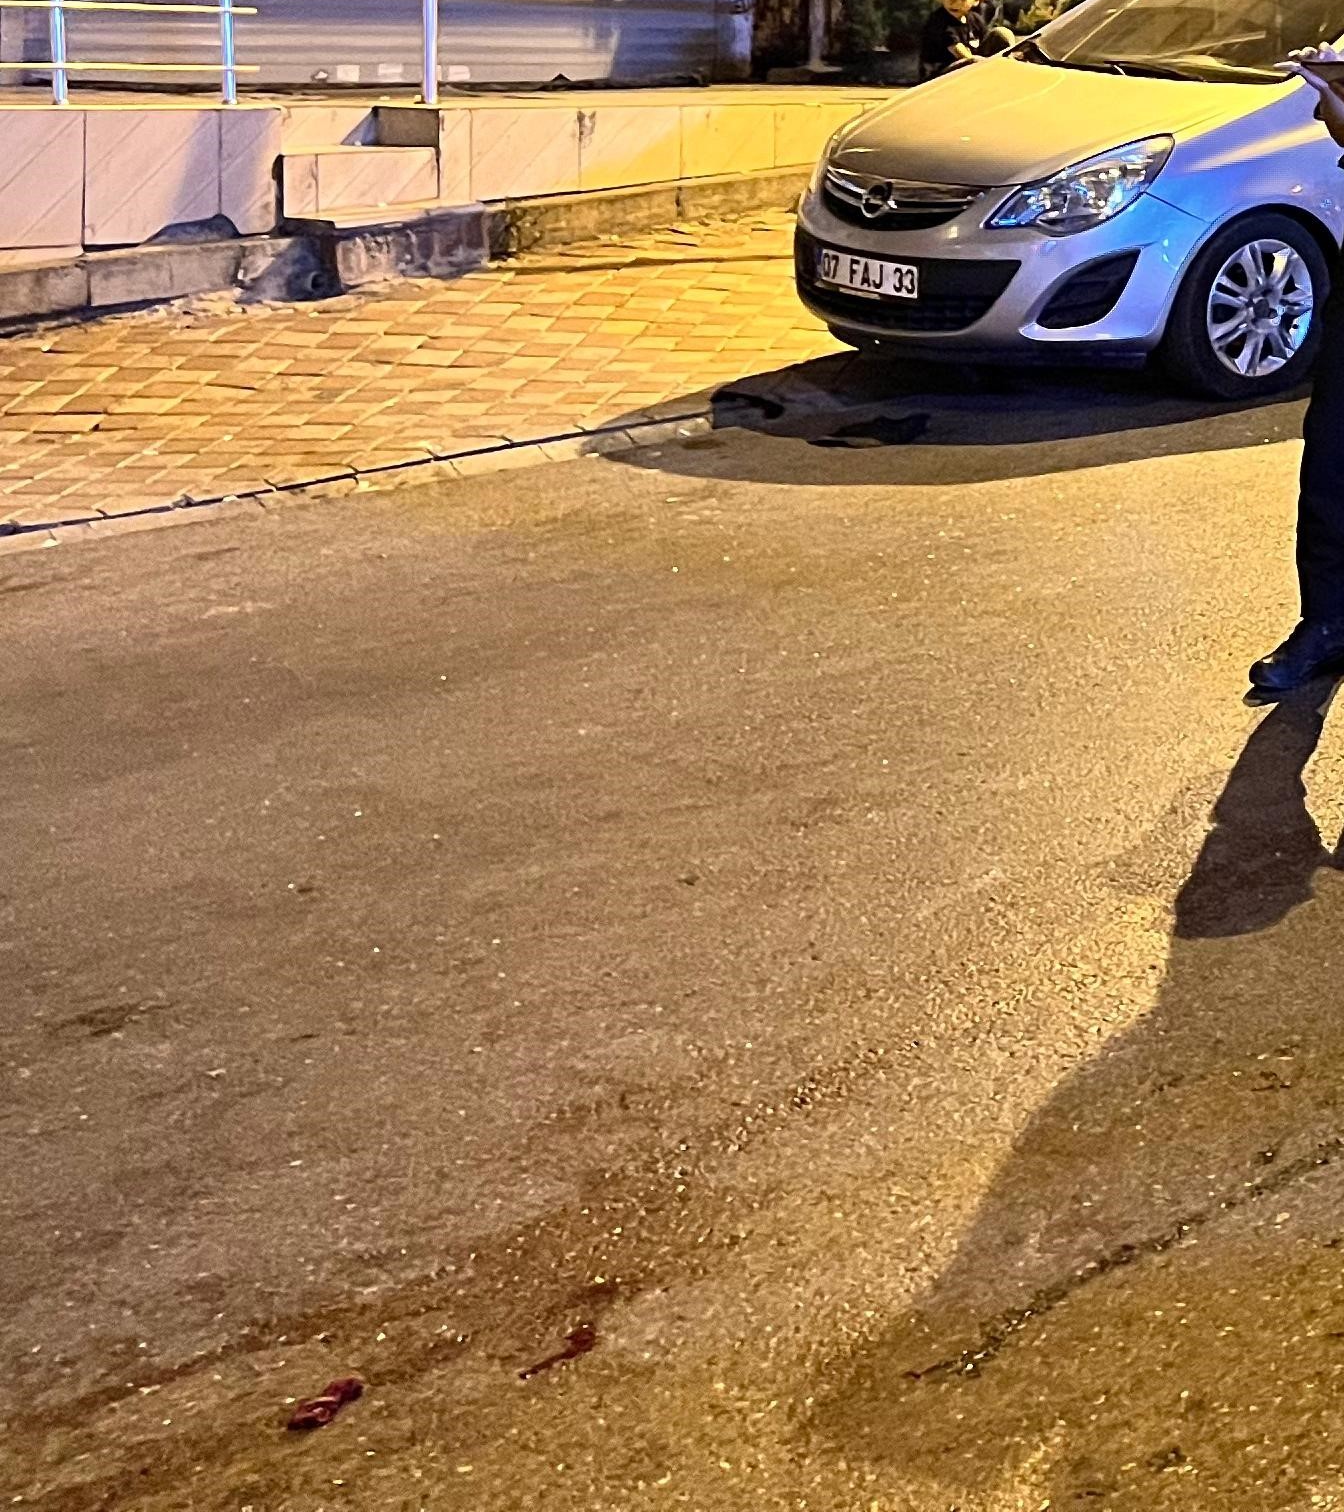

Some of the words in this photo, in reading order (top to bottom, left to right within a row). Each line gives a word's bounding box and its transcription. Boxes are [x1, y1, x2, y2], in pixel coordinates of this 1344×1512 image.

[822, 252, 840, 280] 07
[848, 257, 884, 290] FAJ
[892, 266, 916, 295] 33
